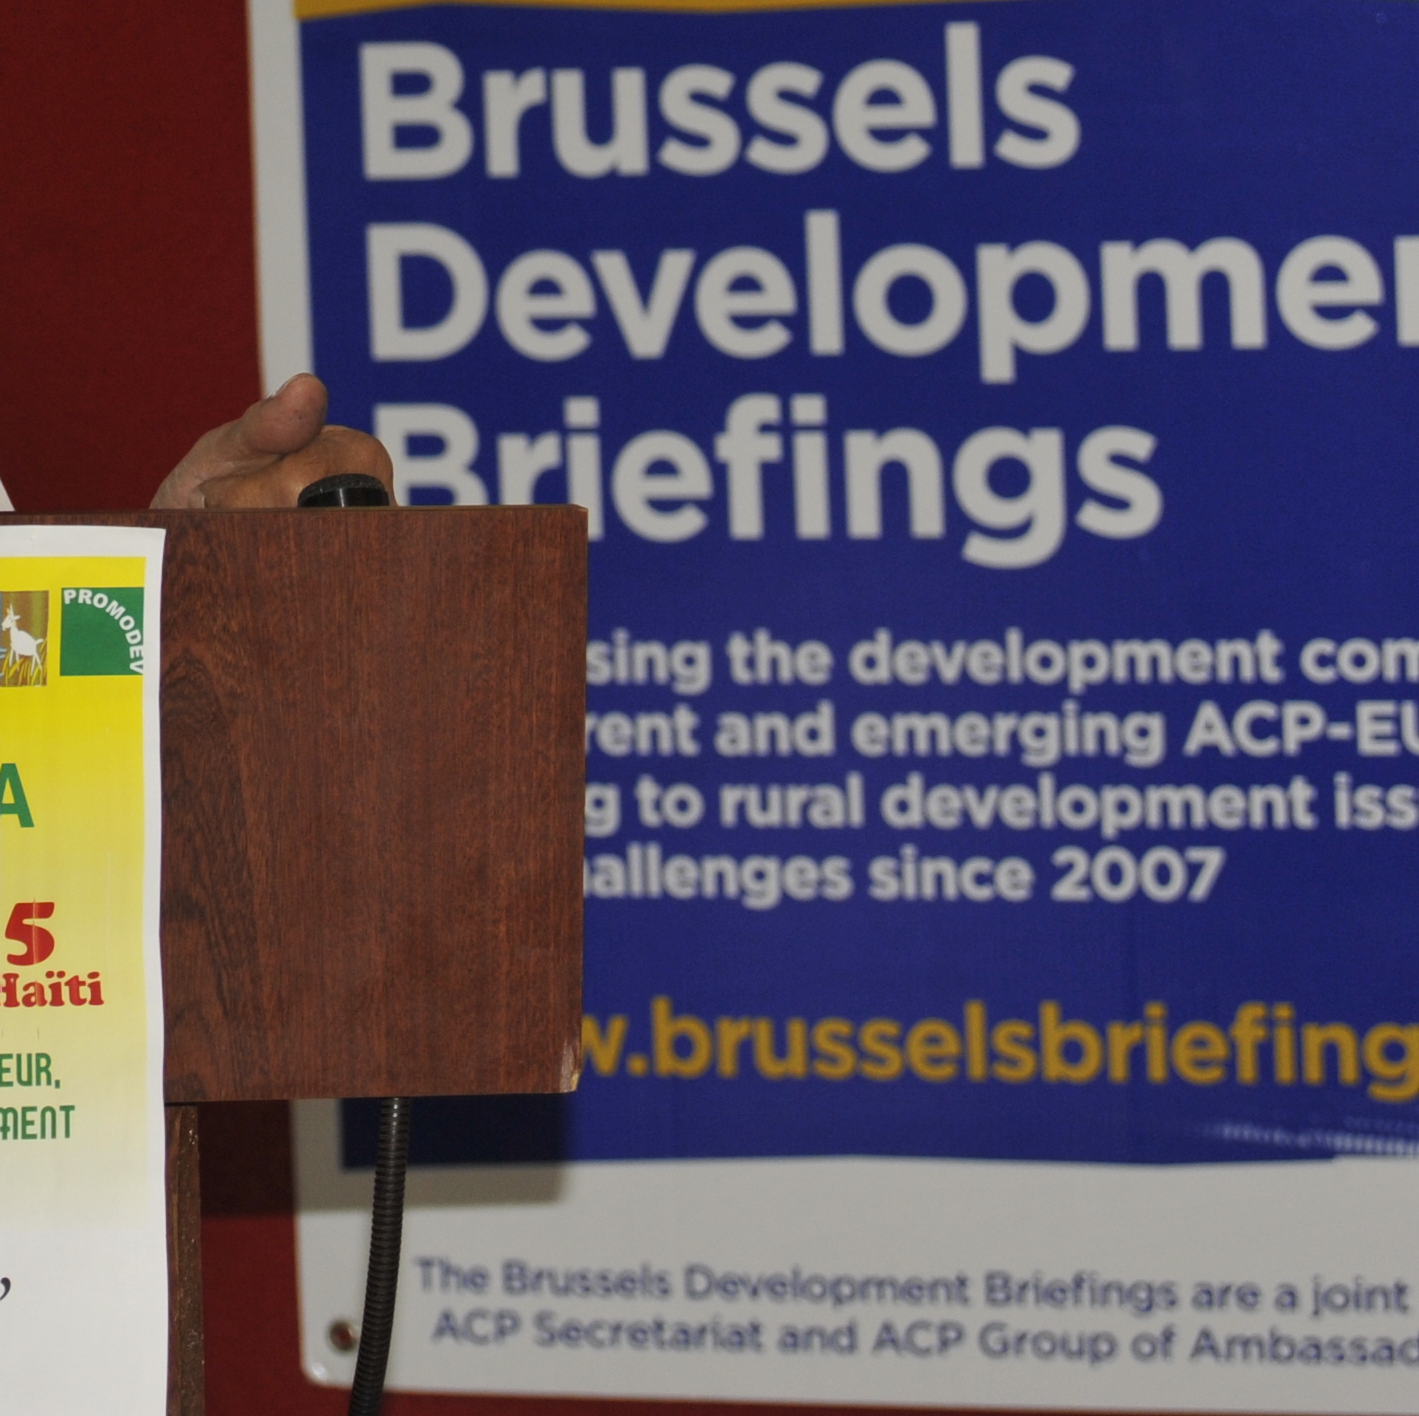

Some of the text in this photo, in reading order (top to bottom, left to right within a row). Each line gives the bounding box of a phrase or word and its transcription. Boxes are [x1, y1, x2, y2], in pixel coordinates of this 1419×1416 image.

[359, 21, 1082, 181] Brussels
[365, 208, 1419, 384] Developme
[372, 394, 1164, 570] Briefings
[63, 588, 144, 676] PROMODEV
[586, 628, 711, 696] sing
[728, 628, 833, 685] the
[849, 627, 1285, 694] development
[714, 700, 834, 757] and
[851, 700, 1165, 768] emerging
[634, 773, 705, 829] to
[719, 771, 865, 829] rural
[880, 772, 1319, 839] development
[582, 842, 1225, 910] allenges since 2007
[5, 900, 56, 967] 5
[582, 995, 1419, 1102] w.brusselsbriefing
[414, 1256, 1410, 1320] The Brussels Development Briefings are a joint
[431, 1307, 522, 1346] ACP
[532, 1308, 764, 1353] Secretariat
[775, 1318, 859, 1356] and
[872, 1318, 966, 1359] ACP
[977, 1320, 1120, 1367] Group
[1129, 1323, 1177, 1361] of
